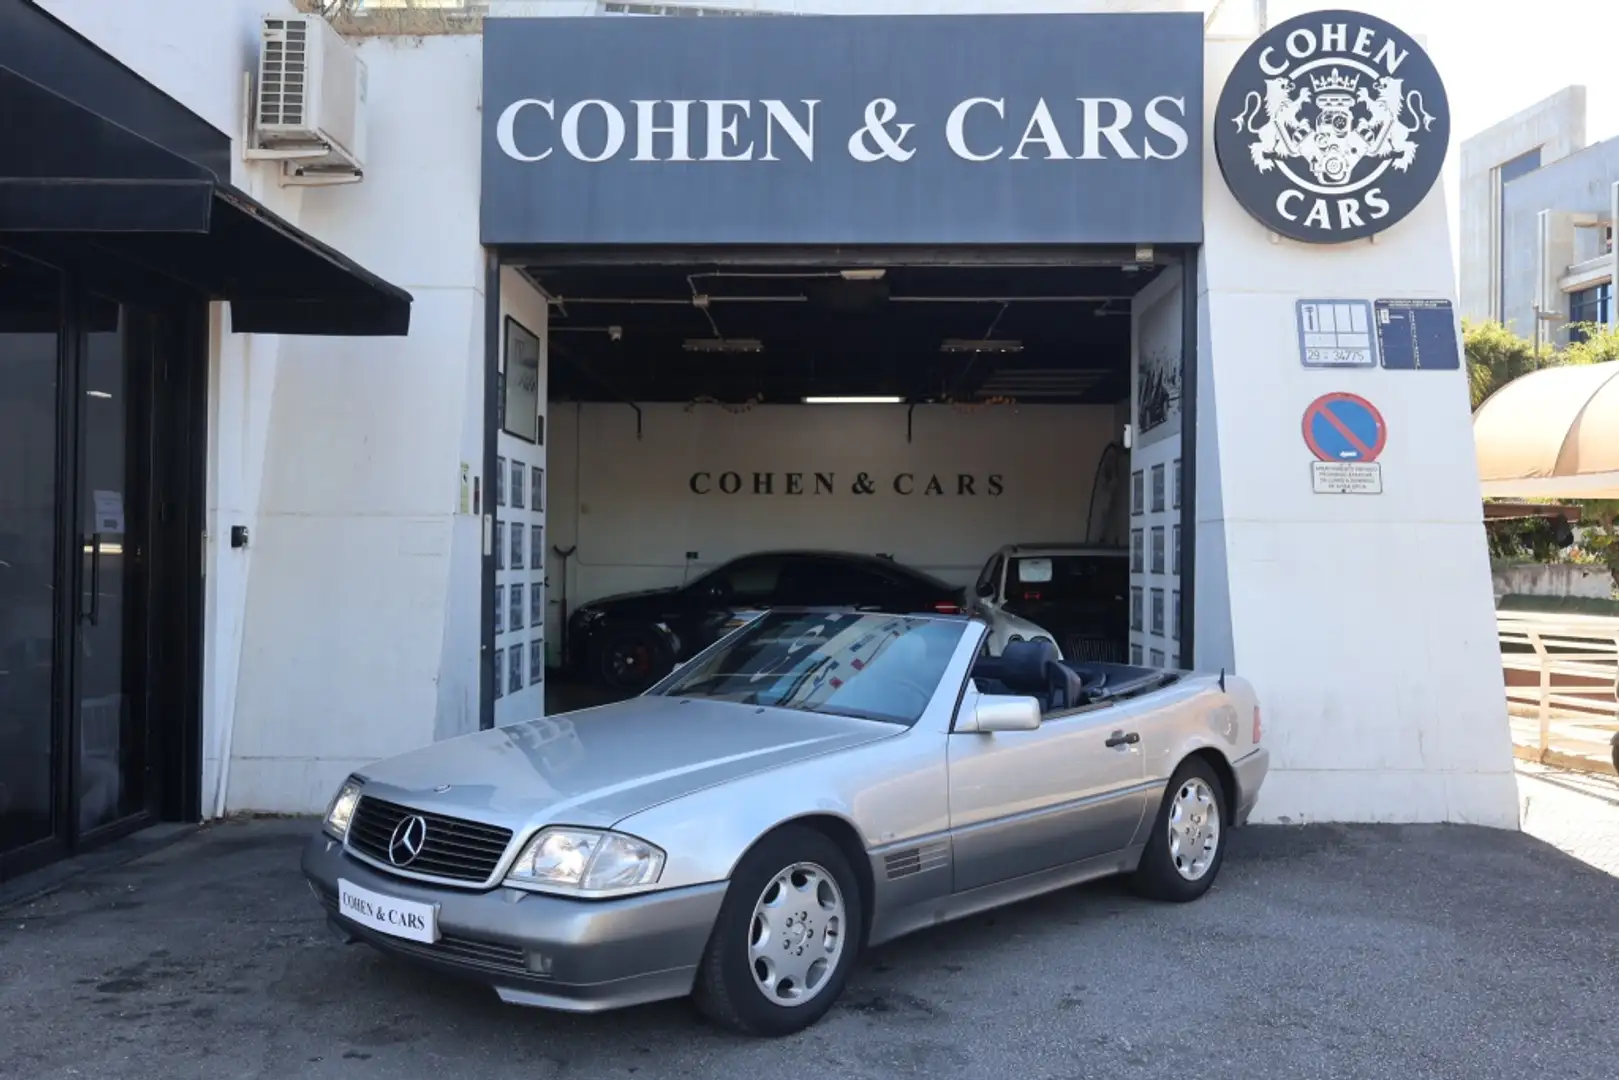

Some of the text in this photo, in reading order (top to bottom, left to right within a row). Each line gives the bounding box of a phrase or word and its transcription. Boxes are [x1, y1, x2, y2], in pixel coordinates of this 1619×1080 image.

[1259, 24, 1409, 76] COHEN
[496, 95, 1189, 163] COHEN & CARS
[1276, 187, 1391, 229] CARS
[690, 471, 1005, 498] COHEN & CARS
[342, 892, 425, 931] COHEN & CARS
